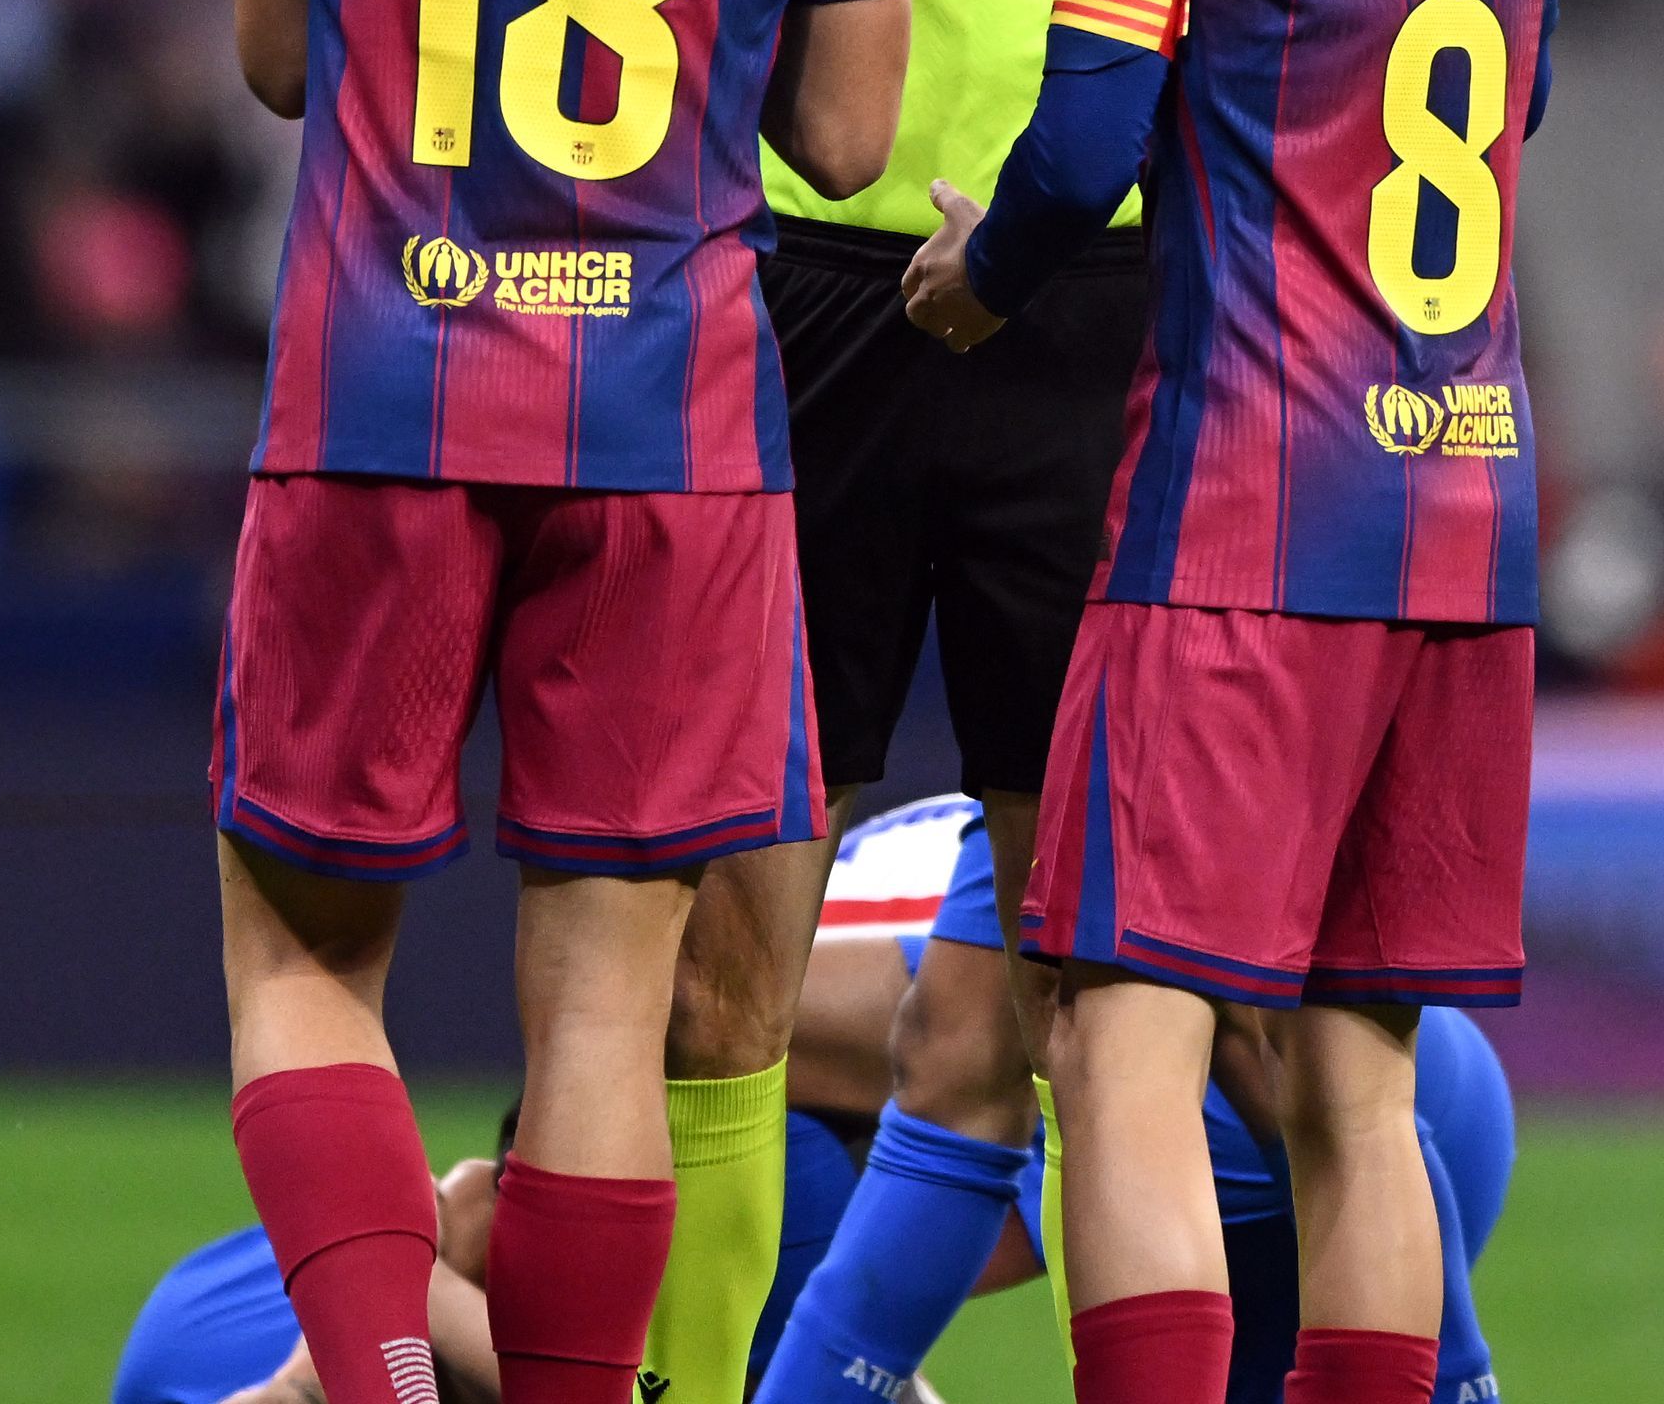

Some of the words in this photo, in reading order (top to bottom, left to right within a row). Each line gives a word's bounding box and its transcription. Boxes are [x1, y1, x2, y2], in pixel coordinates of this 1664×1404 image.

[494, 251, 633, 279] UNHCR
[493, 278, 632, 305] ACNUR
[495, 298, 517, 312] The
[517, 303, 537, 315] UN
[537, 304, 586, 317] Refugee
[586, 305, 630, 318] Agency
[1441, 384, 1513, 415] UNHCR
[1441, 414, 1518, 446] ACNUR
